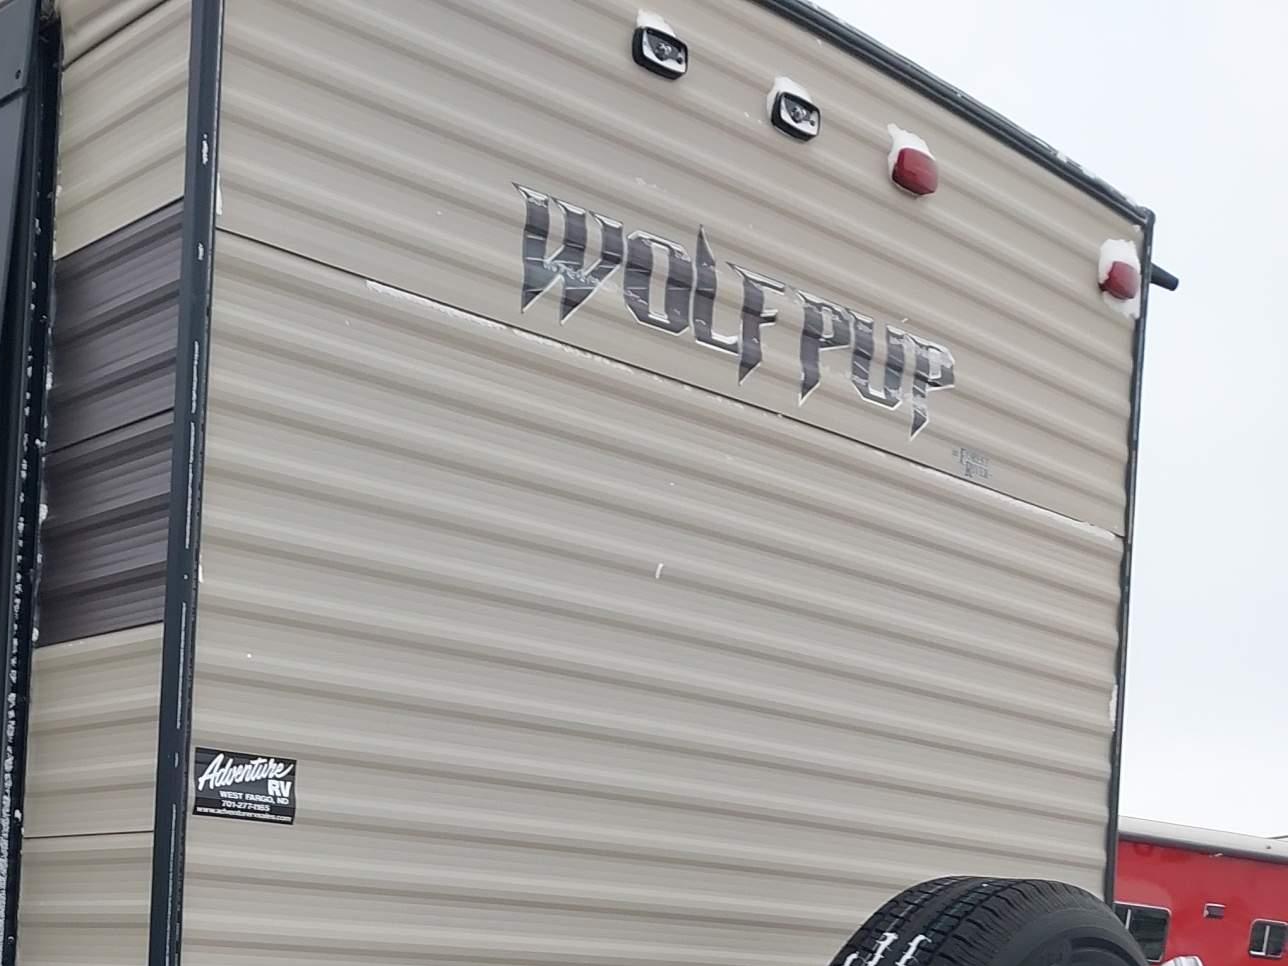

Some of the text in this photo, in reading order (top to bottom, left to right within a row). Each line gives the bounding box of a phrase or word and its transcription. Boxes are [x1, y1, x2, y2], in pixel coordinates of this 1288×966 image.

[512, 182, 955, 441] WOLF PUP
[198, 753, 294, 791] Adventure
[219, 790, 243, 800] WEST
[268, 779, 292, 797] RV
